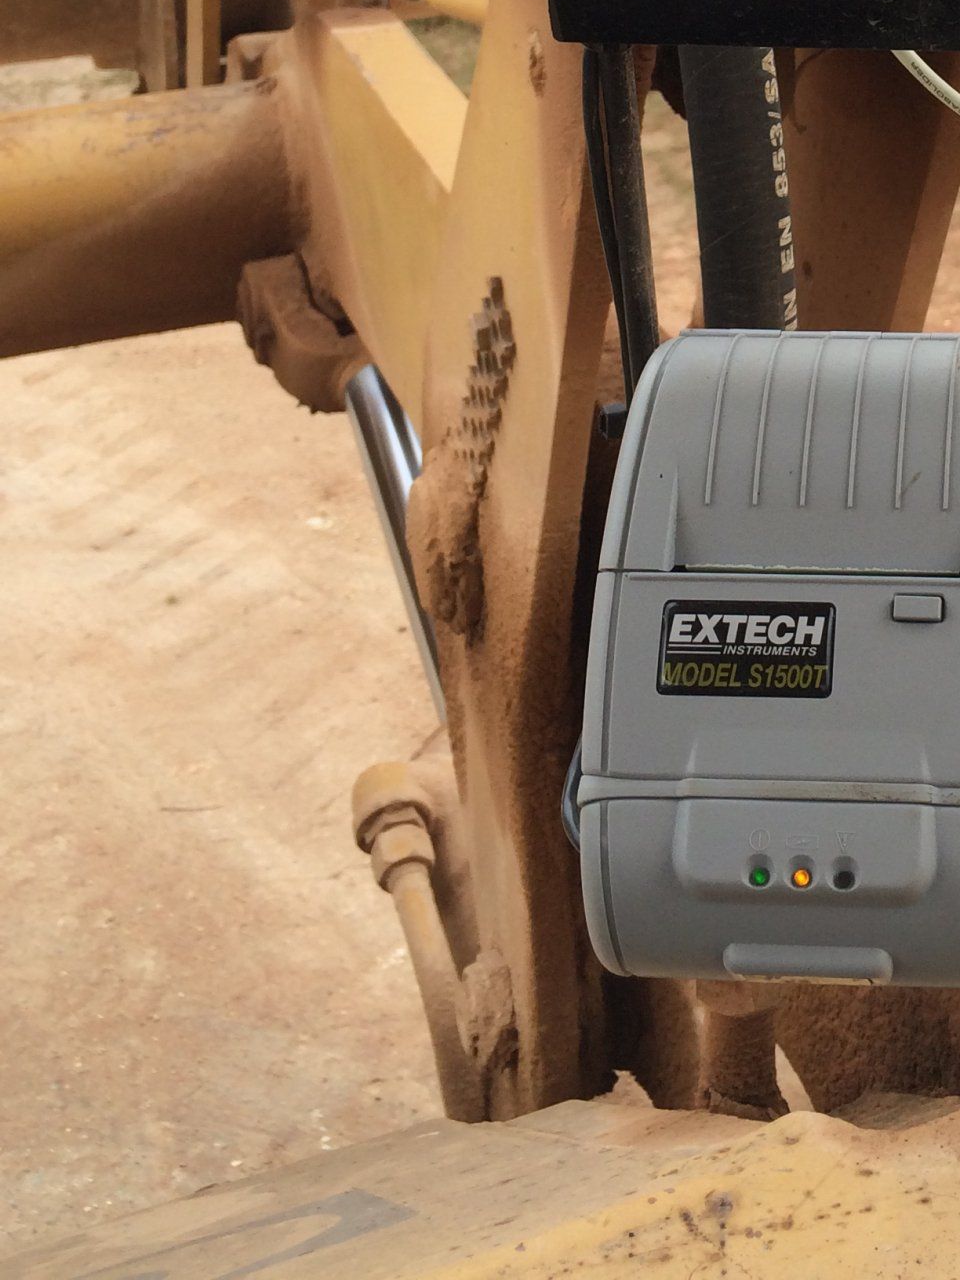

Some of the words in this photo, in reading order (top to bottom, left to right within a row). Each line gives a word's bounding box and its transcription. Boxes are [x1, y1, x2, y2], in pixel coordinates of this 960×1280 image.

[761, 48, 789, 198] 853/SA
[778, 215, 796, 273] EN
[783, 287, 798, 331] IN
[668, 613, 826, 646] EXTECH
[723, 645, 817, 657] INSTRUMENTS
[661, 662, 741, 687] MODEL
[748, 663, 829, 689] S1500T
